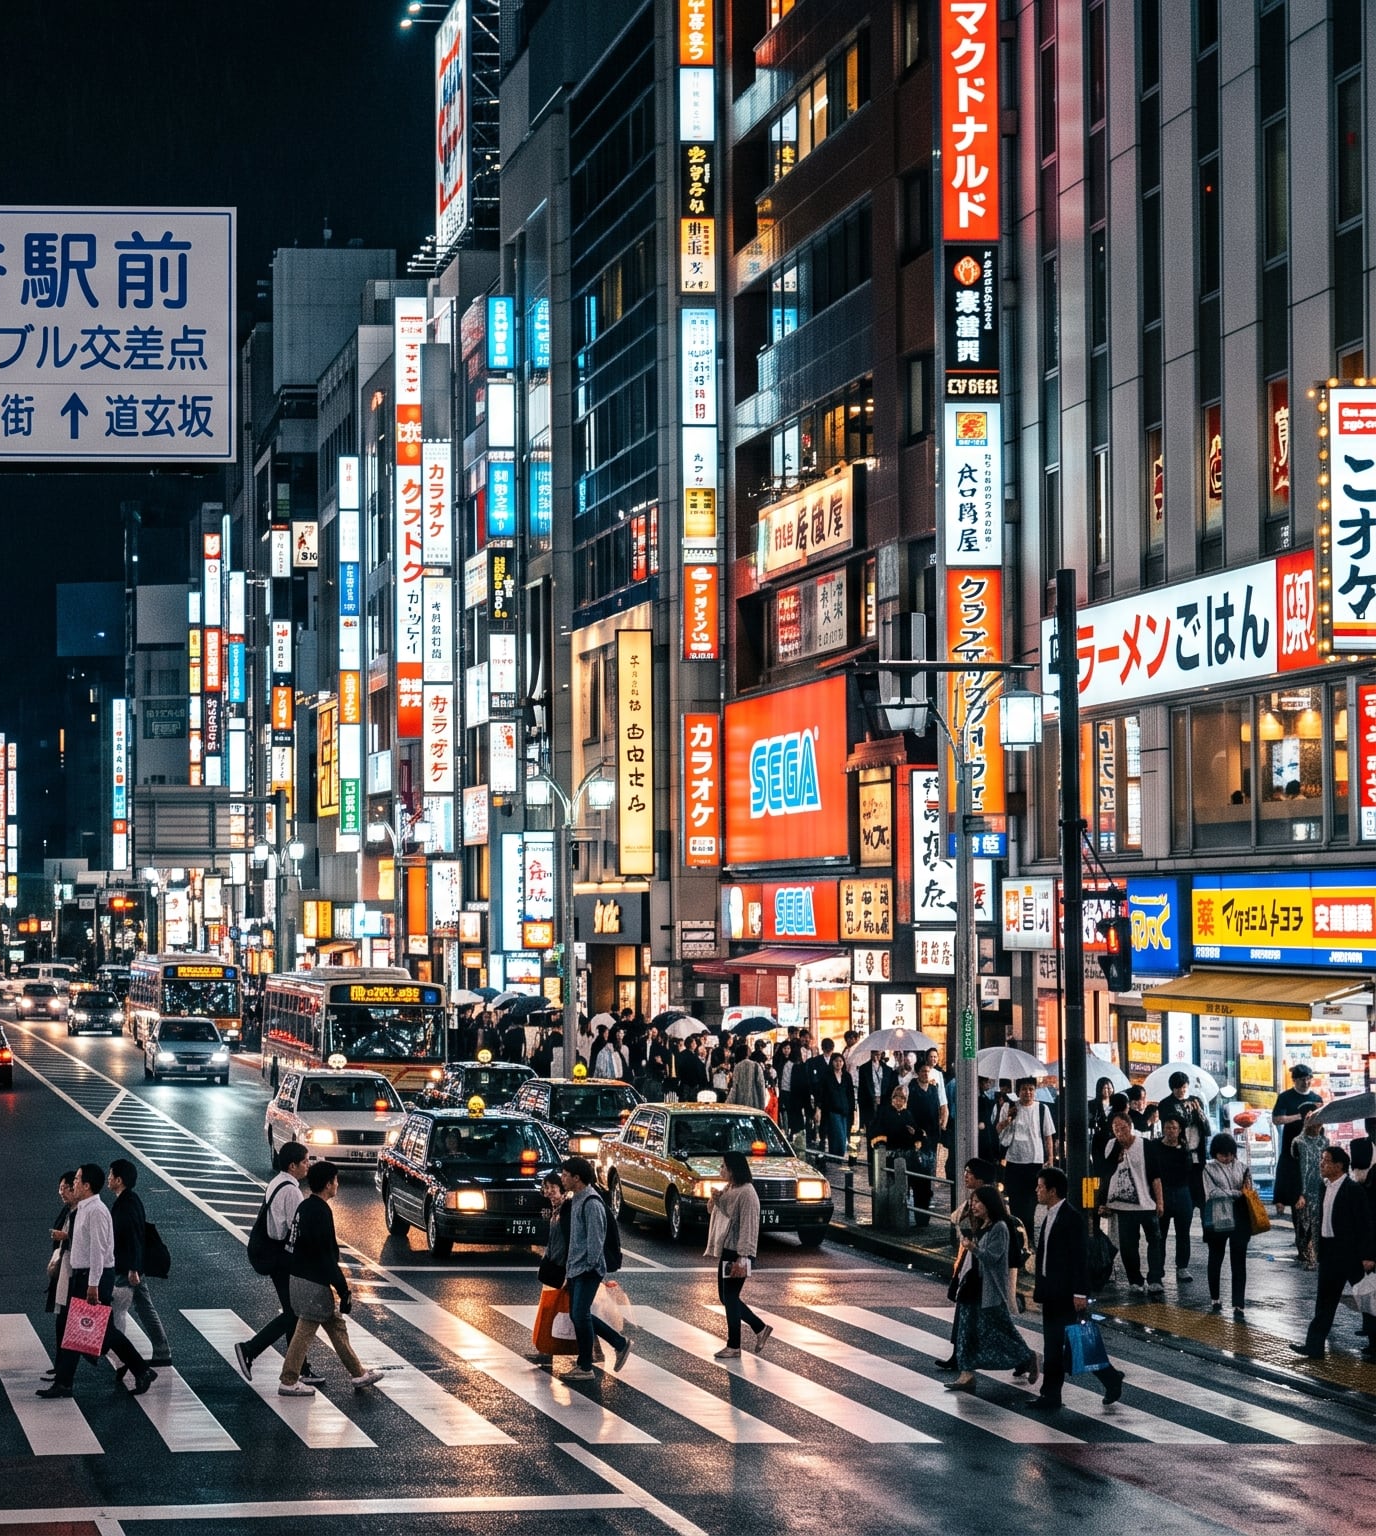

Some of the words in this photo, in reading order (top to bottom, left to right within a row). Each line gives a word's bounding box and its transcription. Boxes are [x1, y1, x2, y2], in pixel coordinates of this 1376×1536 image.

[950, 3, 989, 229] マクドナルド
[105, 394, 213, 437] 道玄坂
[429, 464, 445, 538] カラオケ
[690, 724, 714, 826] カラオケ
[750, 728, 821, 818] SEGA
[775, 888, 814, 936] SEGA
